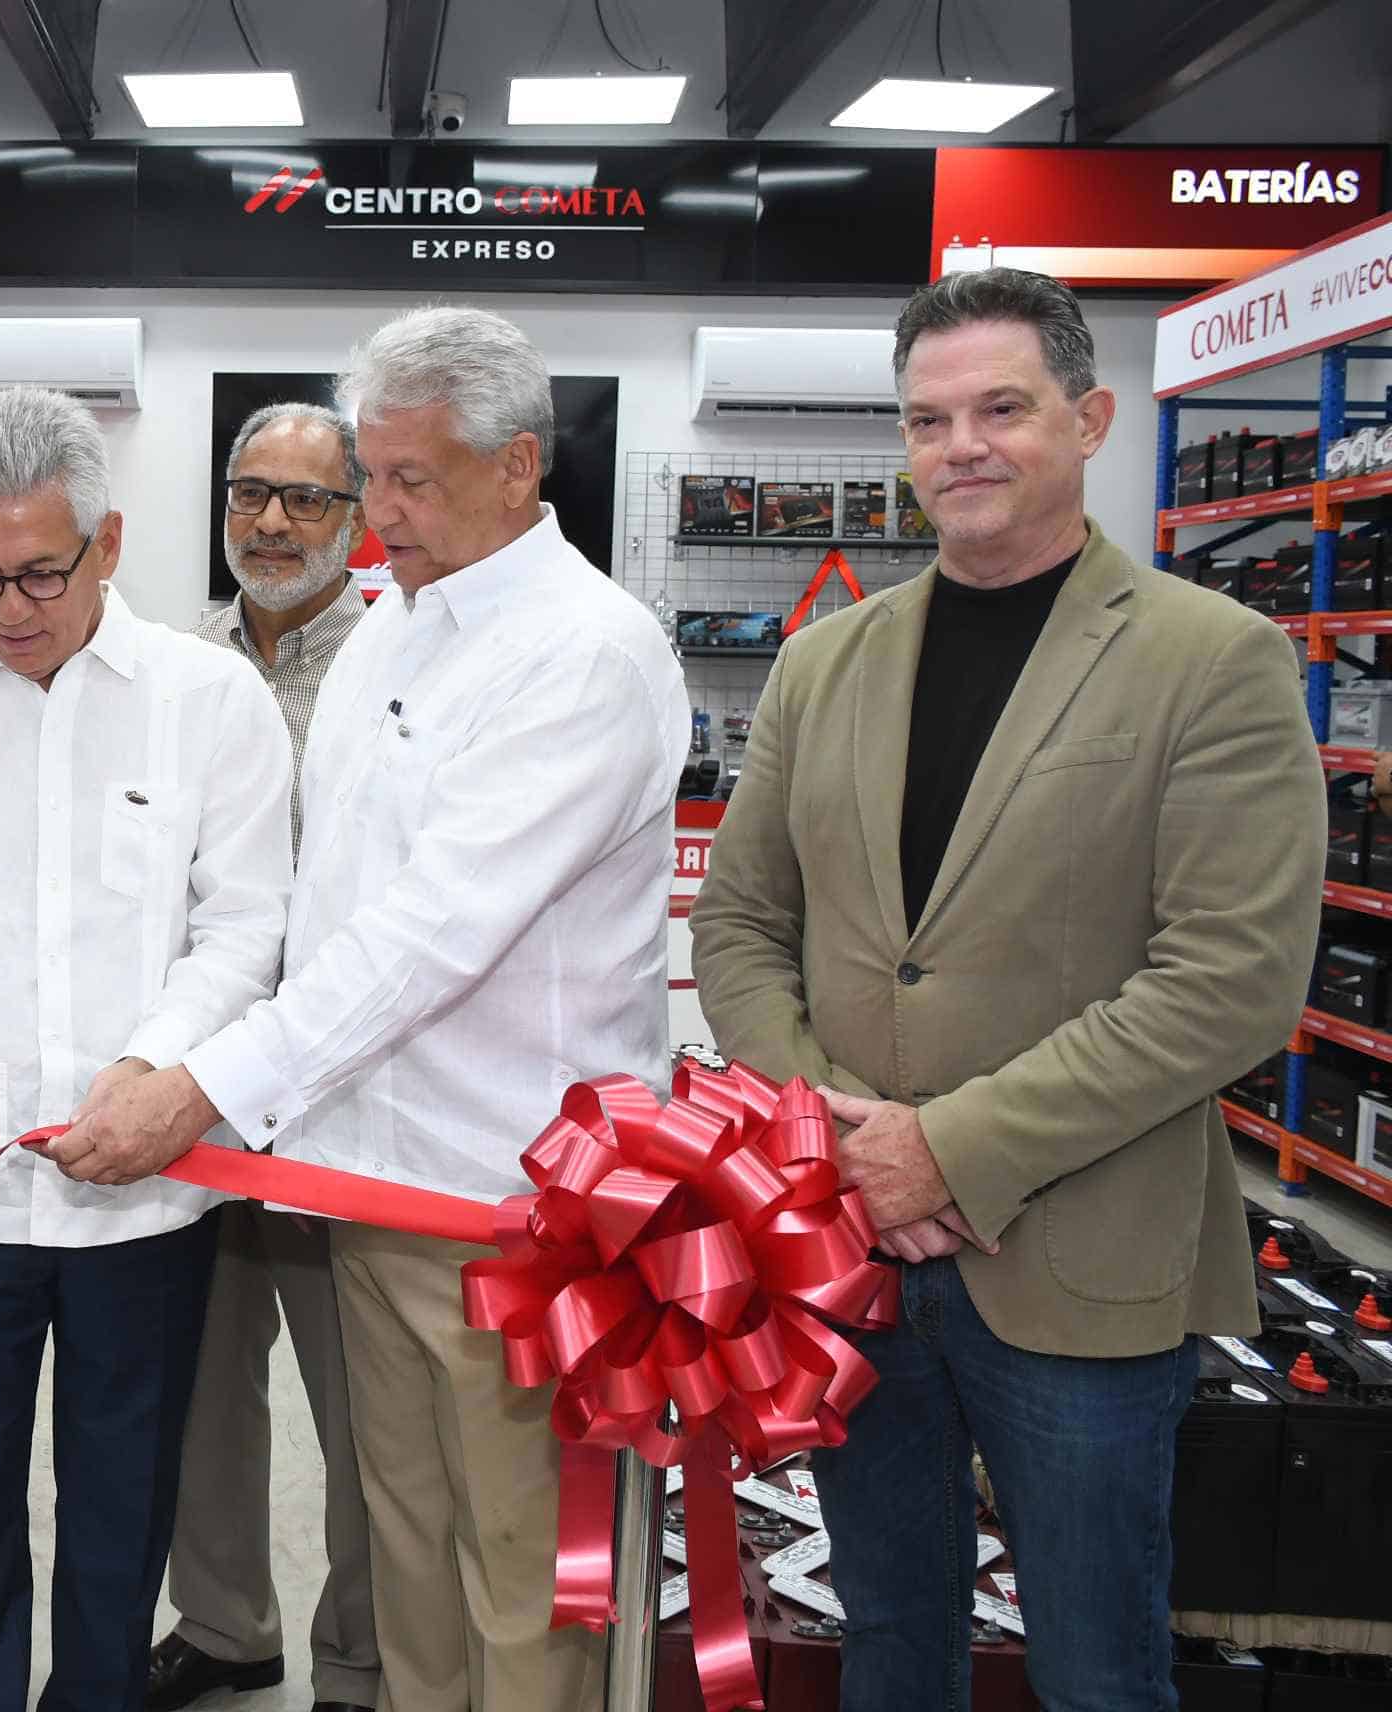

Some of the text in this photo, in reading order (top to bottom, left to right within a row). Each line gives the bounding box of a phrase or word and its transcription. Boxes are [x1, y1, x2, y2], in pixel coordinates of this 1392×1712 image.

[1171, 161, 1360, 203] BATERÍAS
[325, 187, 645, 215] CENTRO COMETA
[412, 240, 555, 259] EXPRESO
[1191, 288, 1289, 361] COMETA
